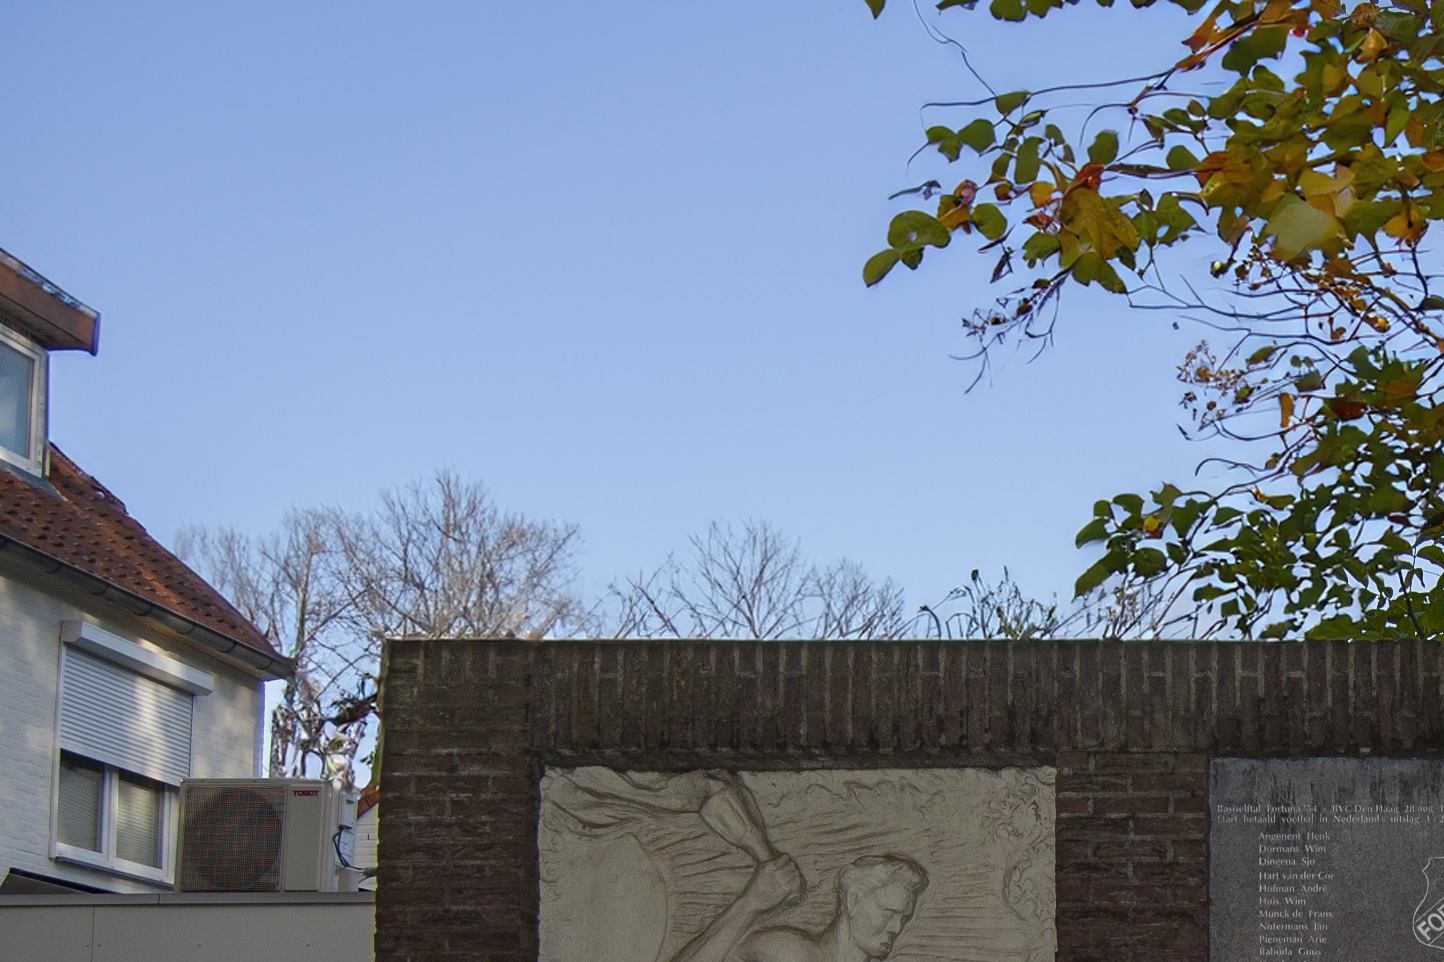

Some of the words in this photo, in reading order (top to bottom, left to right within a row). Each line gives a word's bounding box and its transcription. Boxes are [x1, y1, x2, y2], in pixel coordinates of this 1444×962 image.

[1334, 814, 1380, 823] Nederland
[1259, 844, 1300, 853] Dormans
[1304, 844, 1326, 853] Wim
[1284, 897, 1306, 905] Wim
